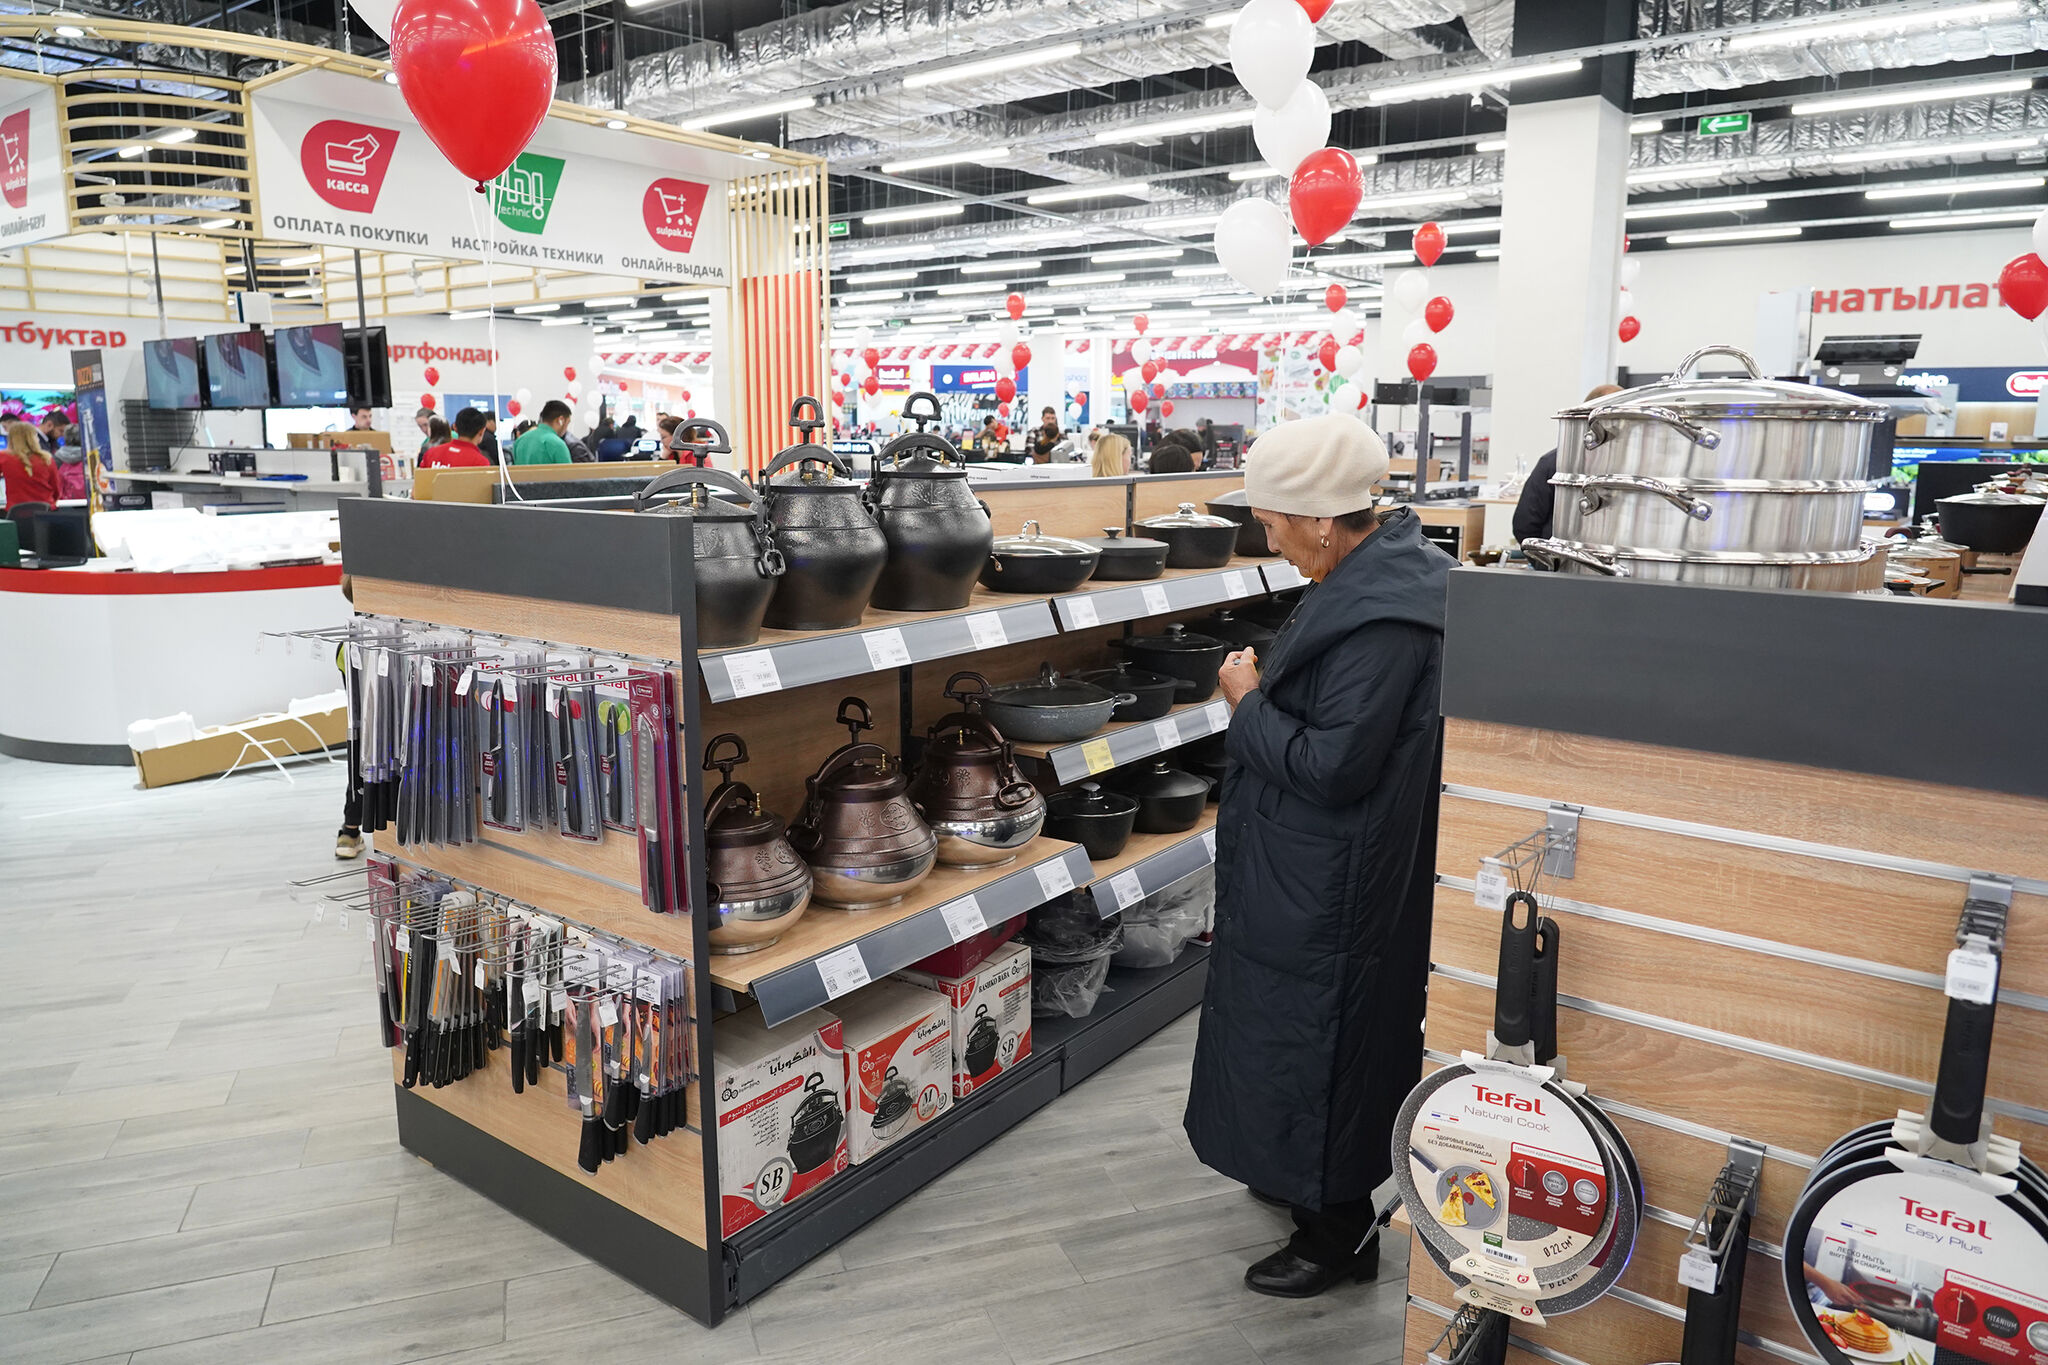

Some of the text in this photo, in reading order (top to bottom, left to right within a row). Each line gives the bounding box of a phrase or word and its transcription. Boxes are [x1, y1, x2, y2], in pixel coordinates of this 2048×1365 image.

[326, 178, 370, 195] касса
[499, 205, 531, 218] echnic
[273, 215, 429, 246] ОПЛАТА ПОКУПКИ
[655, 225, 693, 240] sulpak.kz
[451, 236, 604, 265] НАСТРОЙКА ТЕХНИКИ
[621, 257, 724, 278] ОНЛАЙН-ВЫДАЧА
[1001, 1037, 1015, 1057] SB
[1471, 1084, 1546, 1116] Tefal
[1464, 1104, 1513, 1124] Natural
[1517, 1115, 1551, 1133] Cook
[1427, 1138, 1493, 1158] БЕЗ ДОБАВЛЕНИЯ МАСЛА
[1465, 1140, 1485, 1150] БЛЮДА
[760, 1167, 784, 1196] SB
[1899, 1196, 1993, 1240] Tefal
[1551, 1243, 1562, 1255] 22
[1905, 1223, 1983, 1255] Easy Plus
[1860, 1260, 1891, 1274] СНАРУЖИ
[1862, 1253, 1885, 1265] МЫТЬ
[1986, 1313, 2018, 1330] TITANIUM
